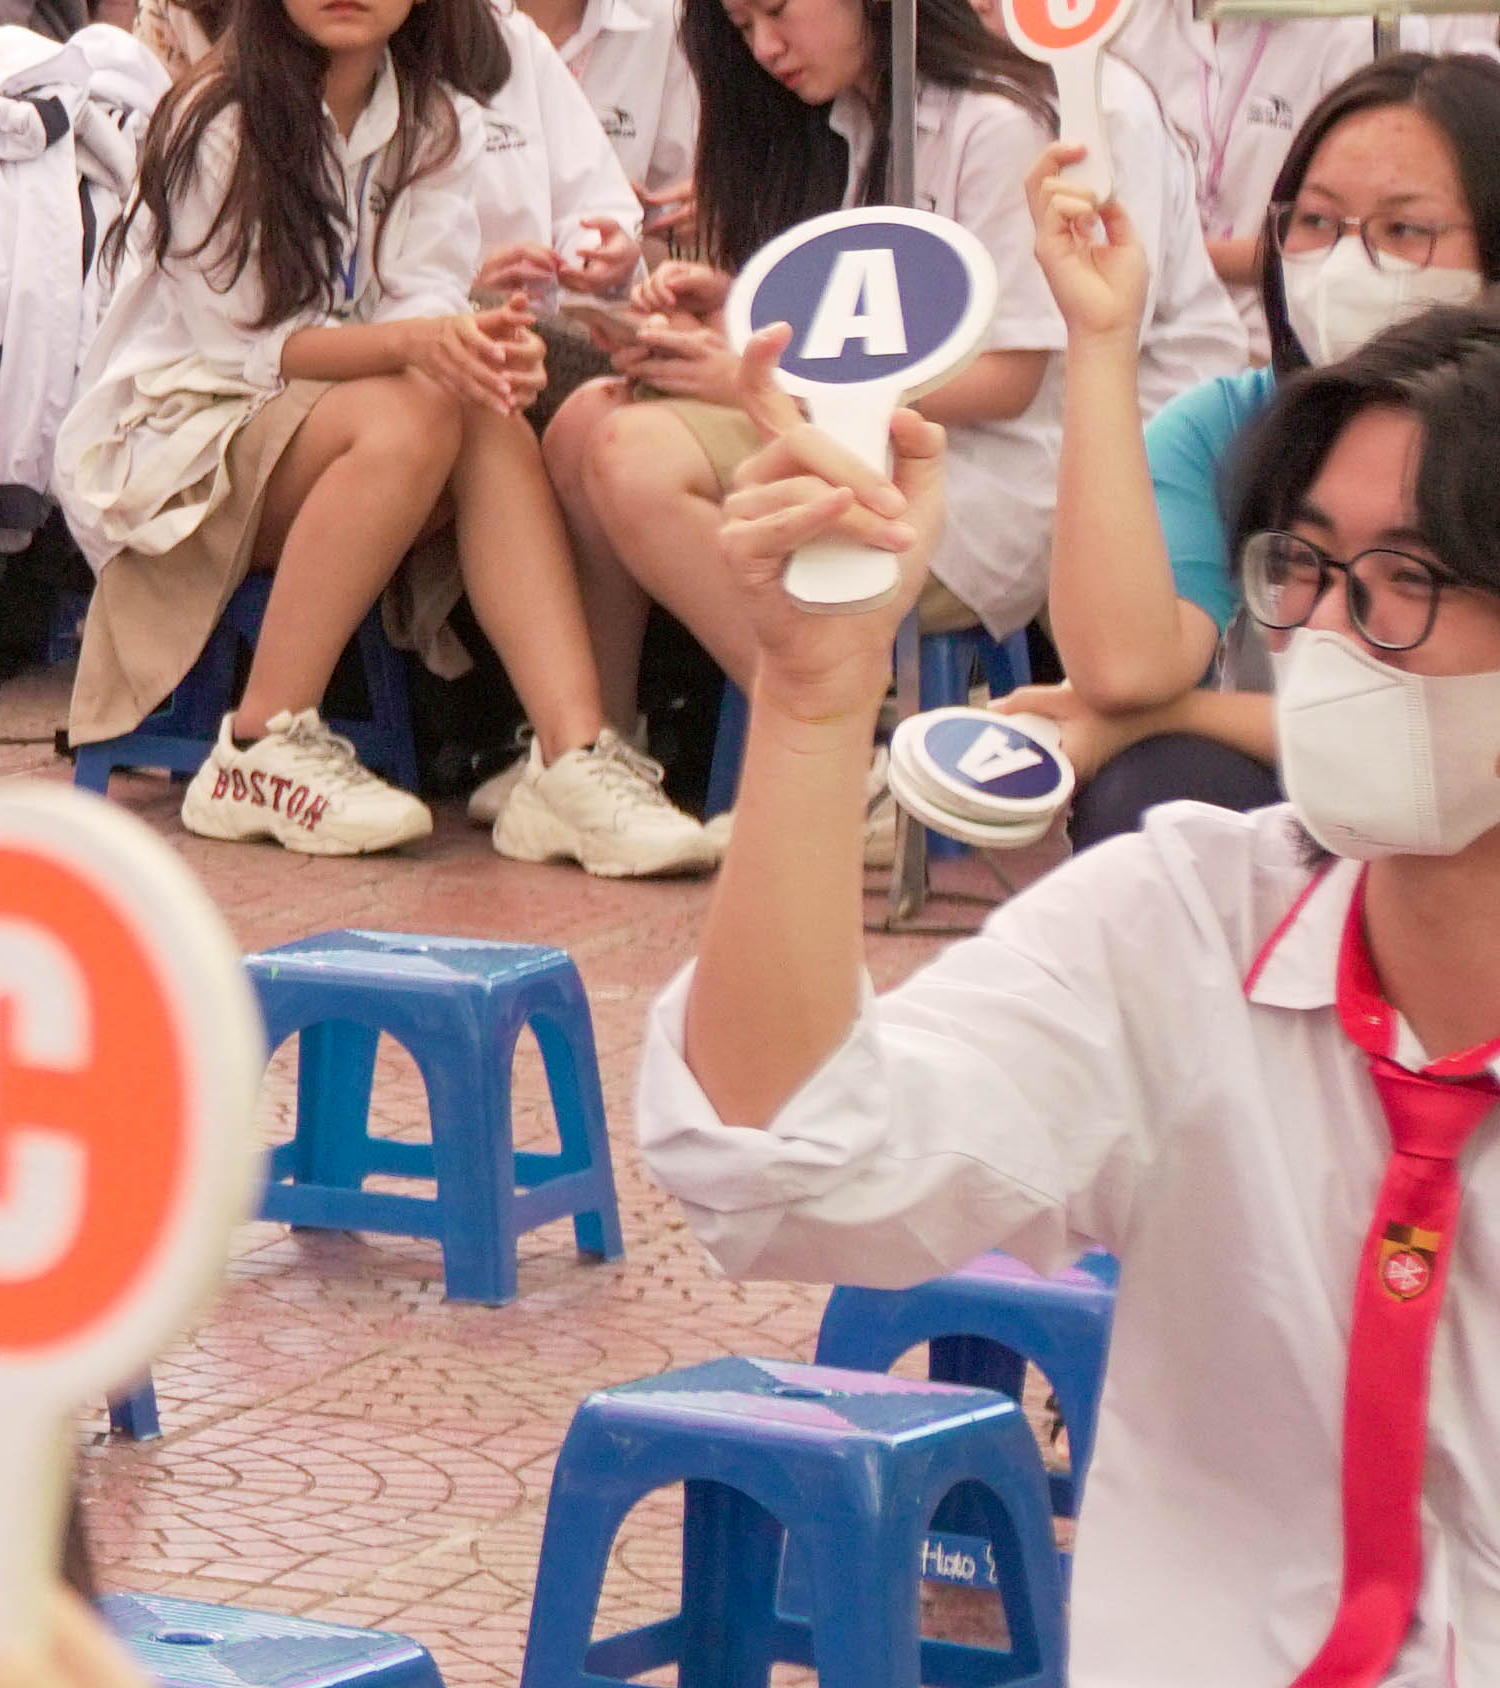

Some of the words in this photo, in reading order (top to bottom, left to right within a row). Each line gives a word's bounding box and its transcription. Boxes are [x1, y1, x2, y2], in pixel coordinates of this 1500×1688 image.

[802, 248, 907, 360] A
[952, 722, 1045, 786] A
[211, 768, 329, 833] BOSTON
